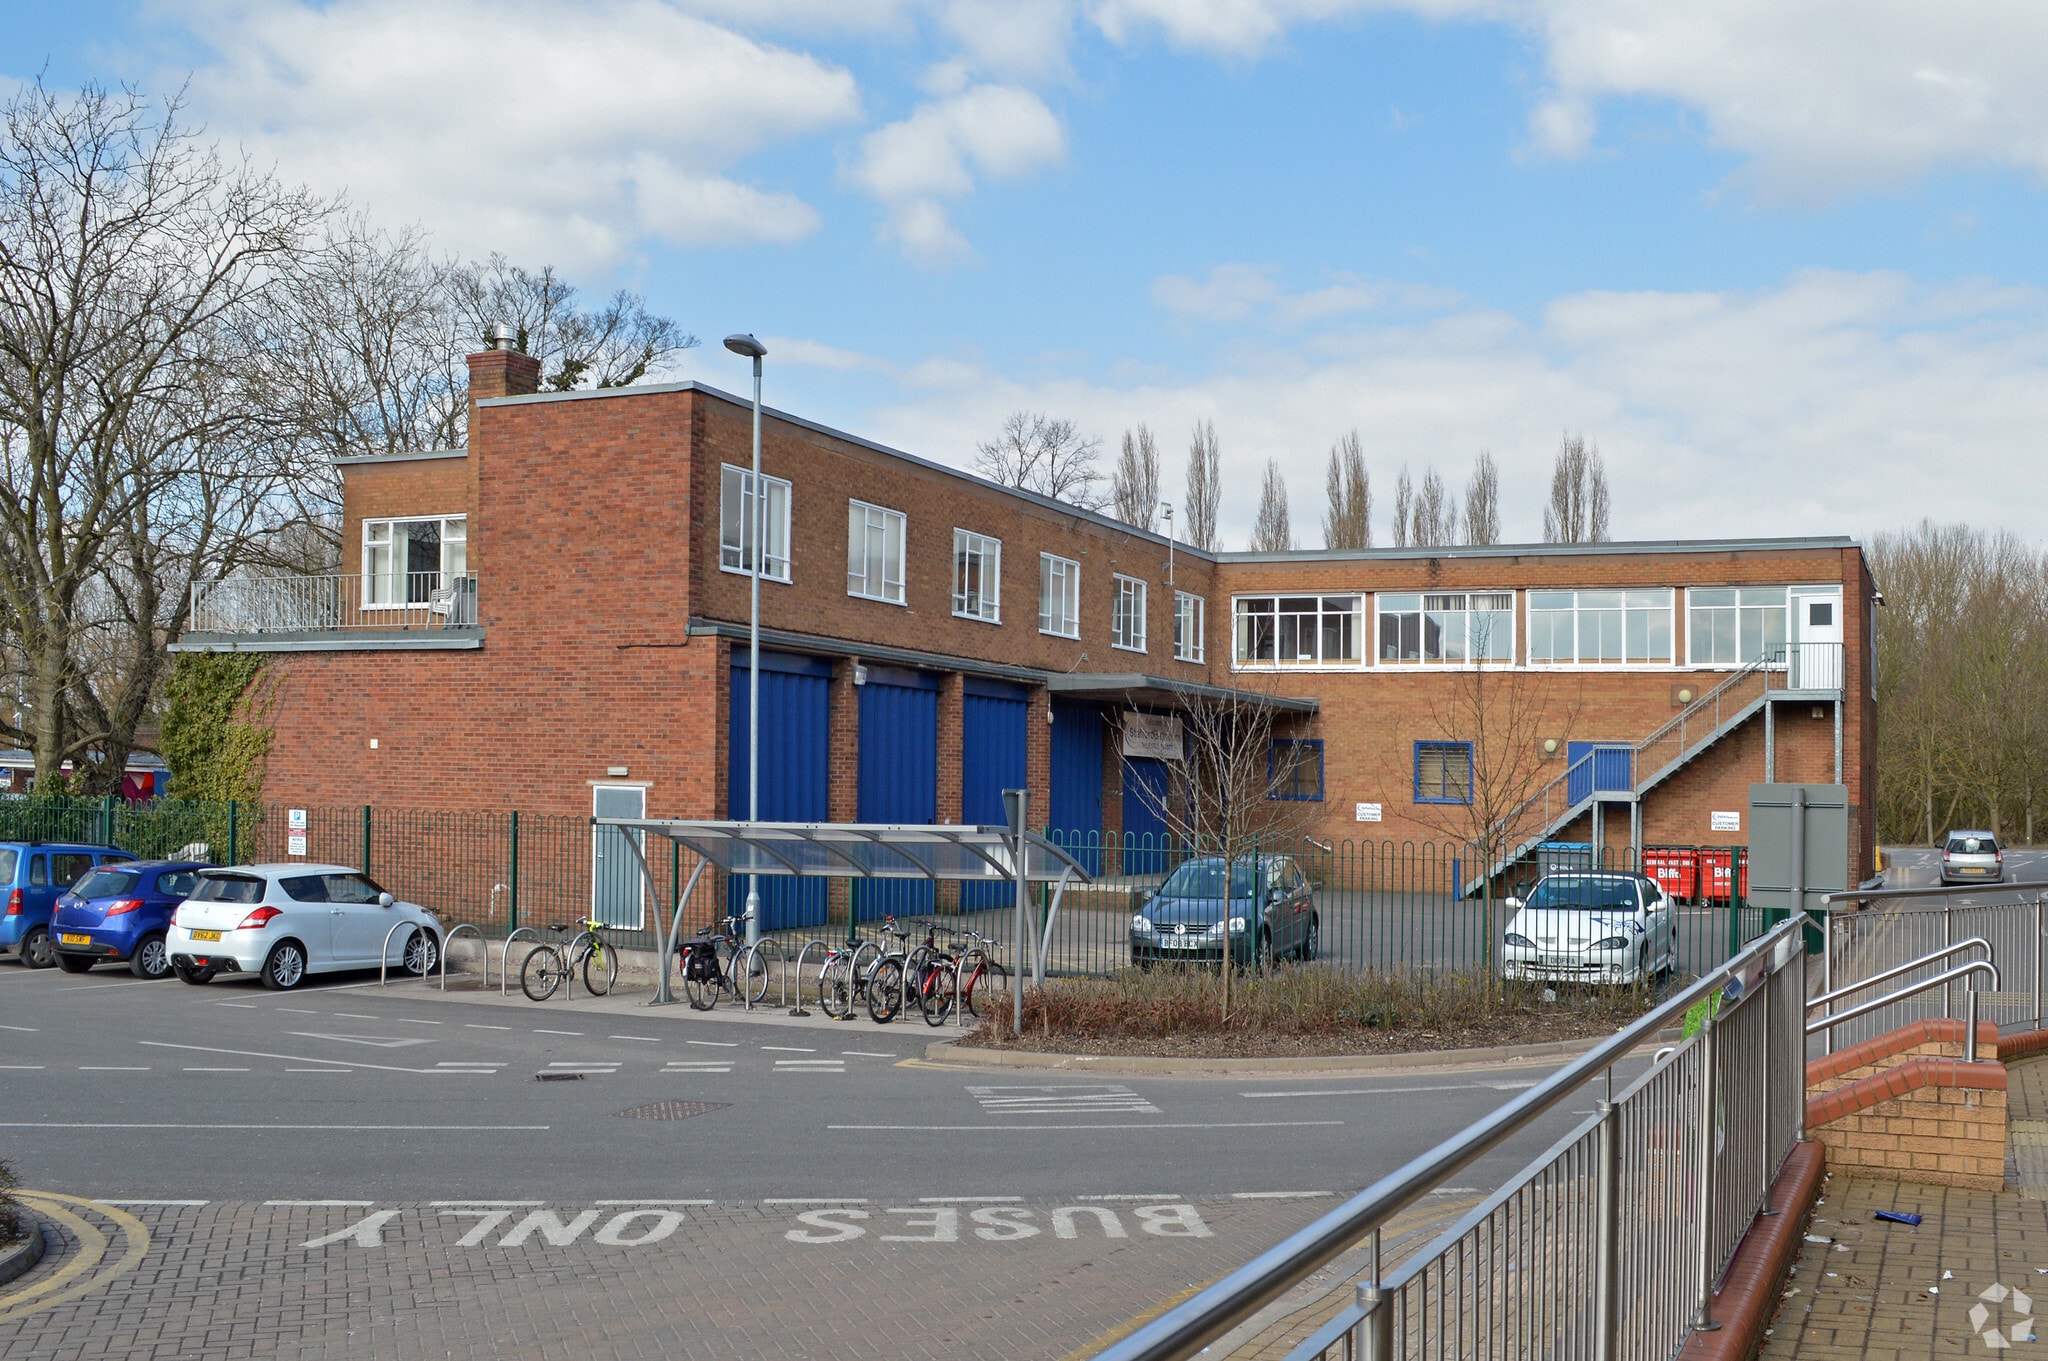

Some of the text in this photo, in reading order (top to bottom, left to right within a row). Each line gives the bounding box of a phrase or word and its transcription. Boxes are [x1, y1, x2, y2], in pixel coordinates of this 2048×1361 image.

[1714, 867, 1732, 878] Biff
[299, 1204, 1215, 1248] BUSES ONLY
